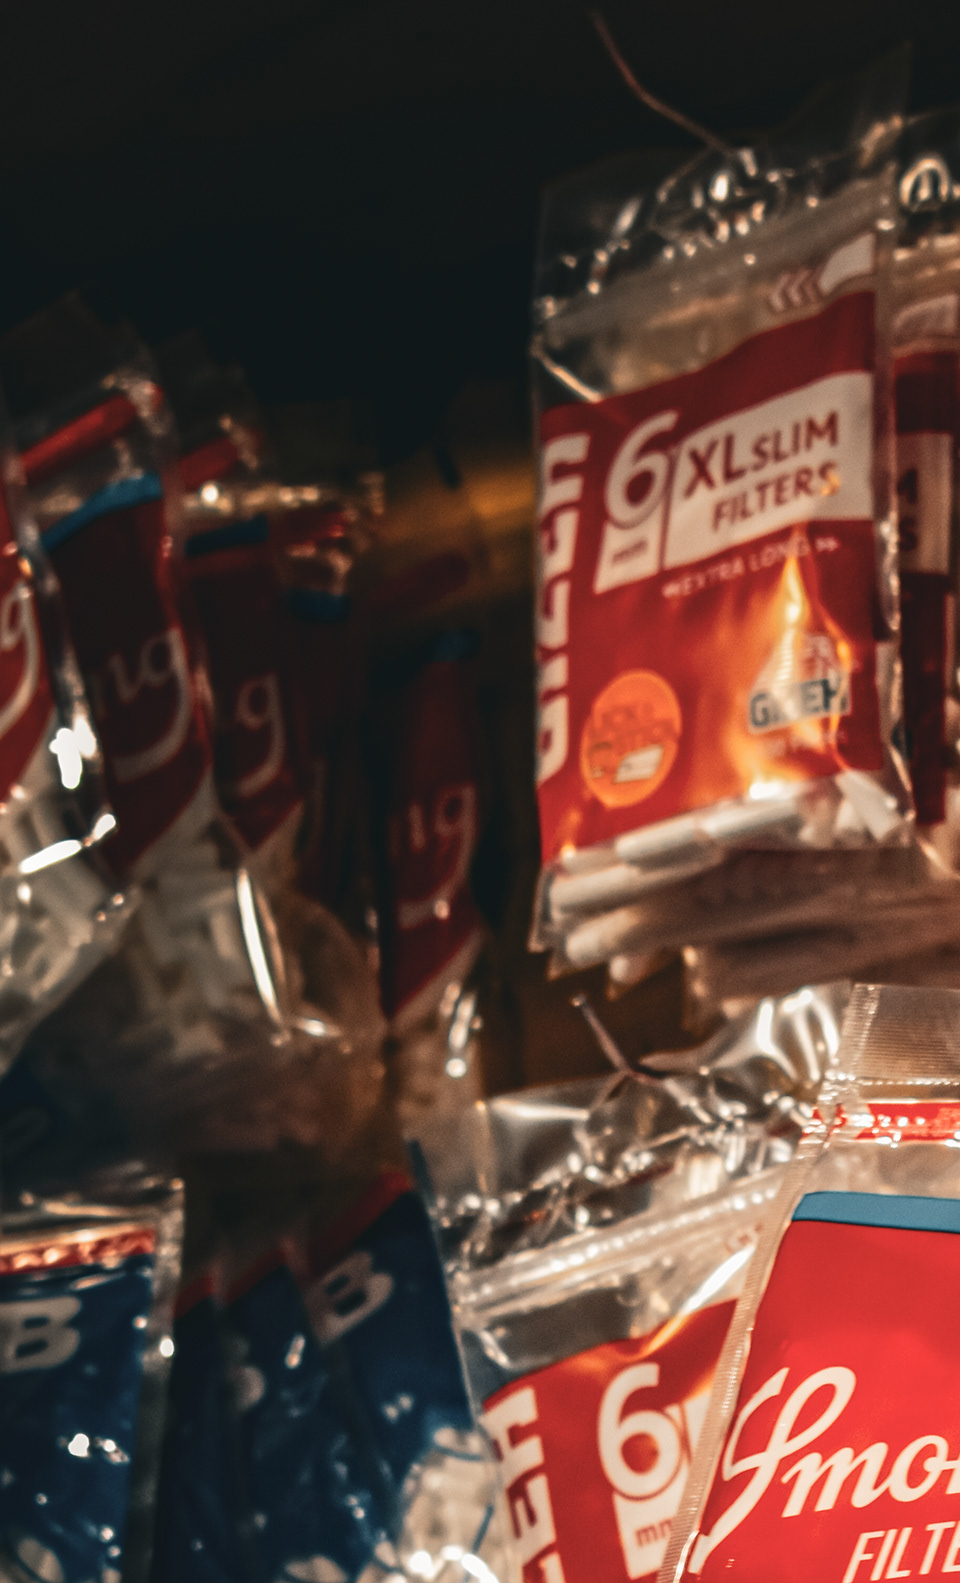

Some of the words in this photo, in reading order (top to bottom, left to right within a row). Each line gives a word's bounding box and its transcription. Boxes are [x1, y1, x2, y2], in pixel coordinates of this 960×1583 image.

[604, 408, 682, 530] 6
[713, 460, 842, 533] FILTERS
[597, 1361, 683, 1499] 6
